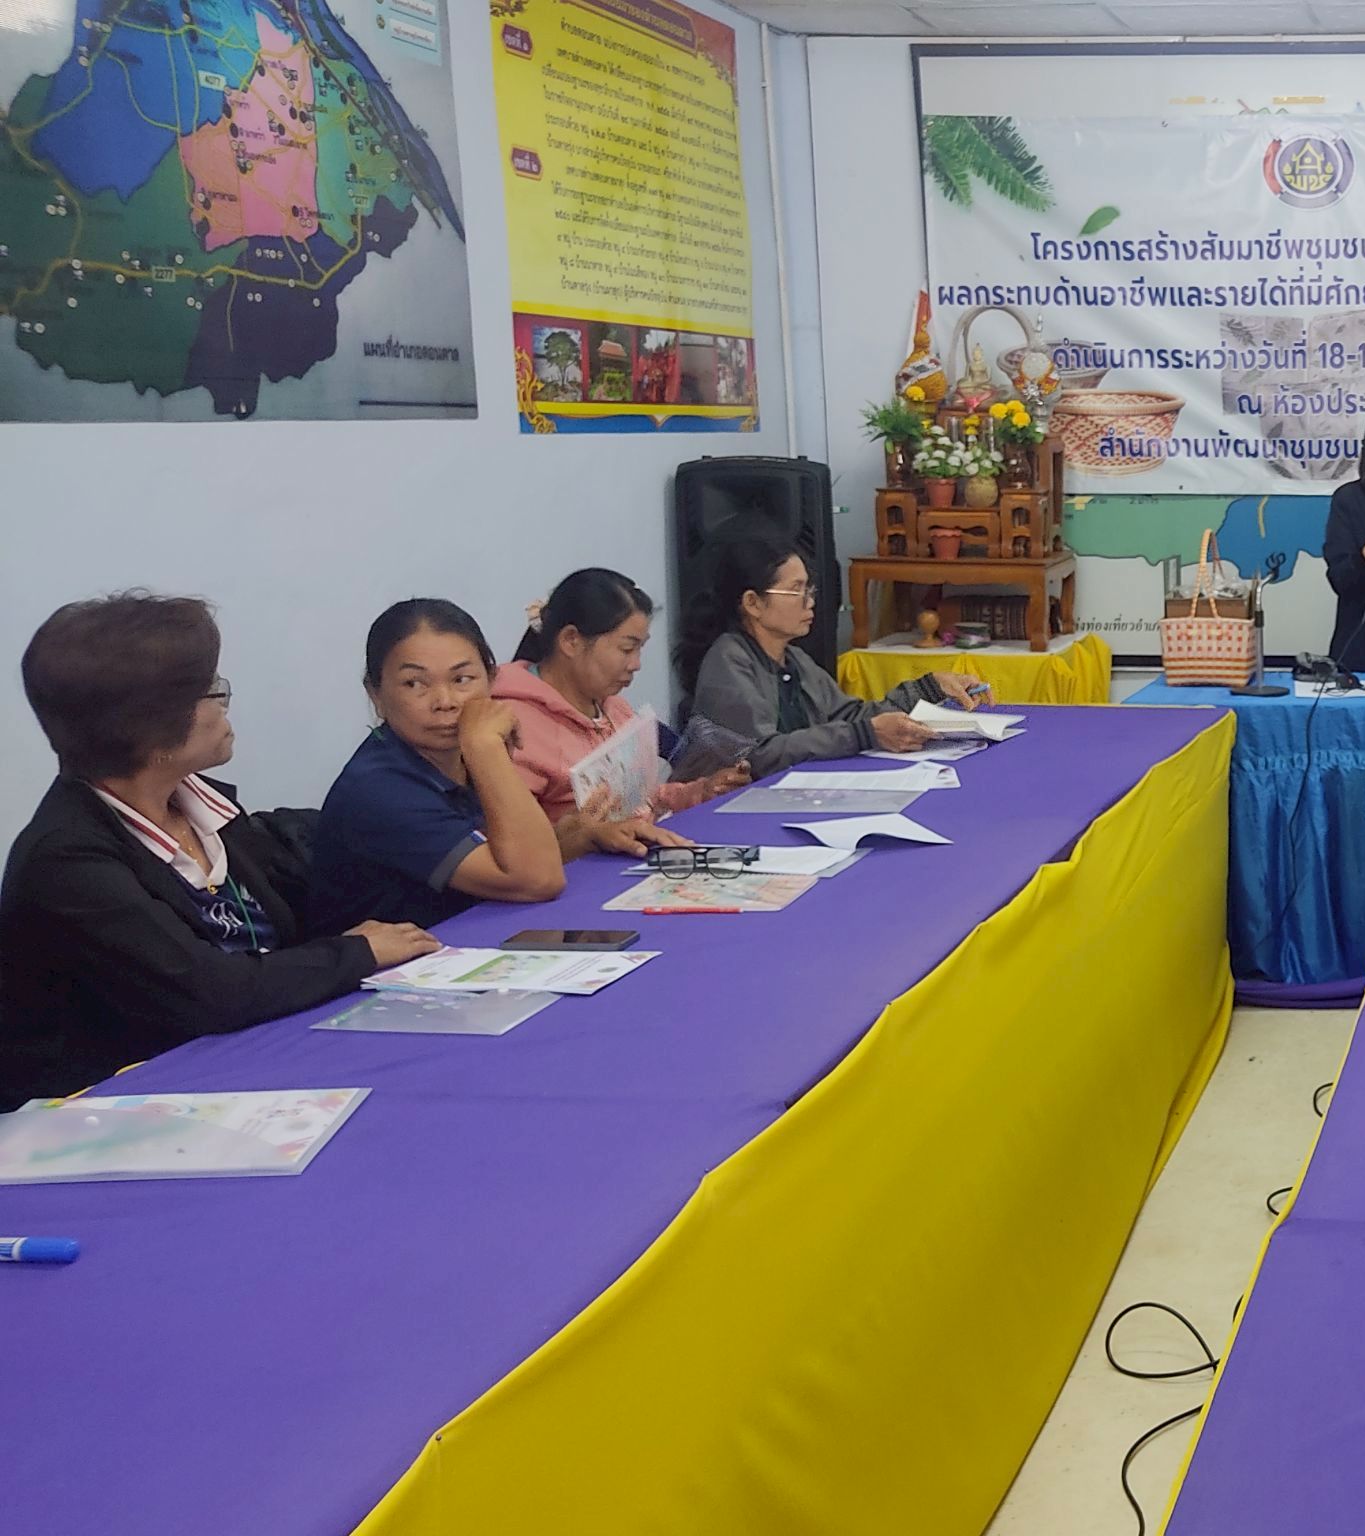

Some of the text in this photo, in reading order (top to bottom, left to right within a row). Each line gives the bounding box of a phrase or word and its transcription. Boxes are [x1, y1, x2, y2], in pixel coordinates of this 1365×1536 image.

[1053, 331, 1308, 370] ดำเนินการระหว่างวันที่
[1237, 394, 1262, 415] ณ
